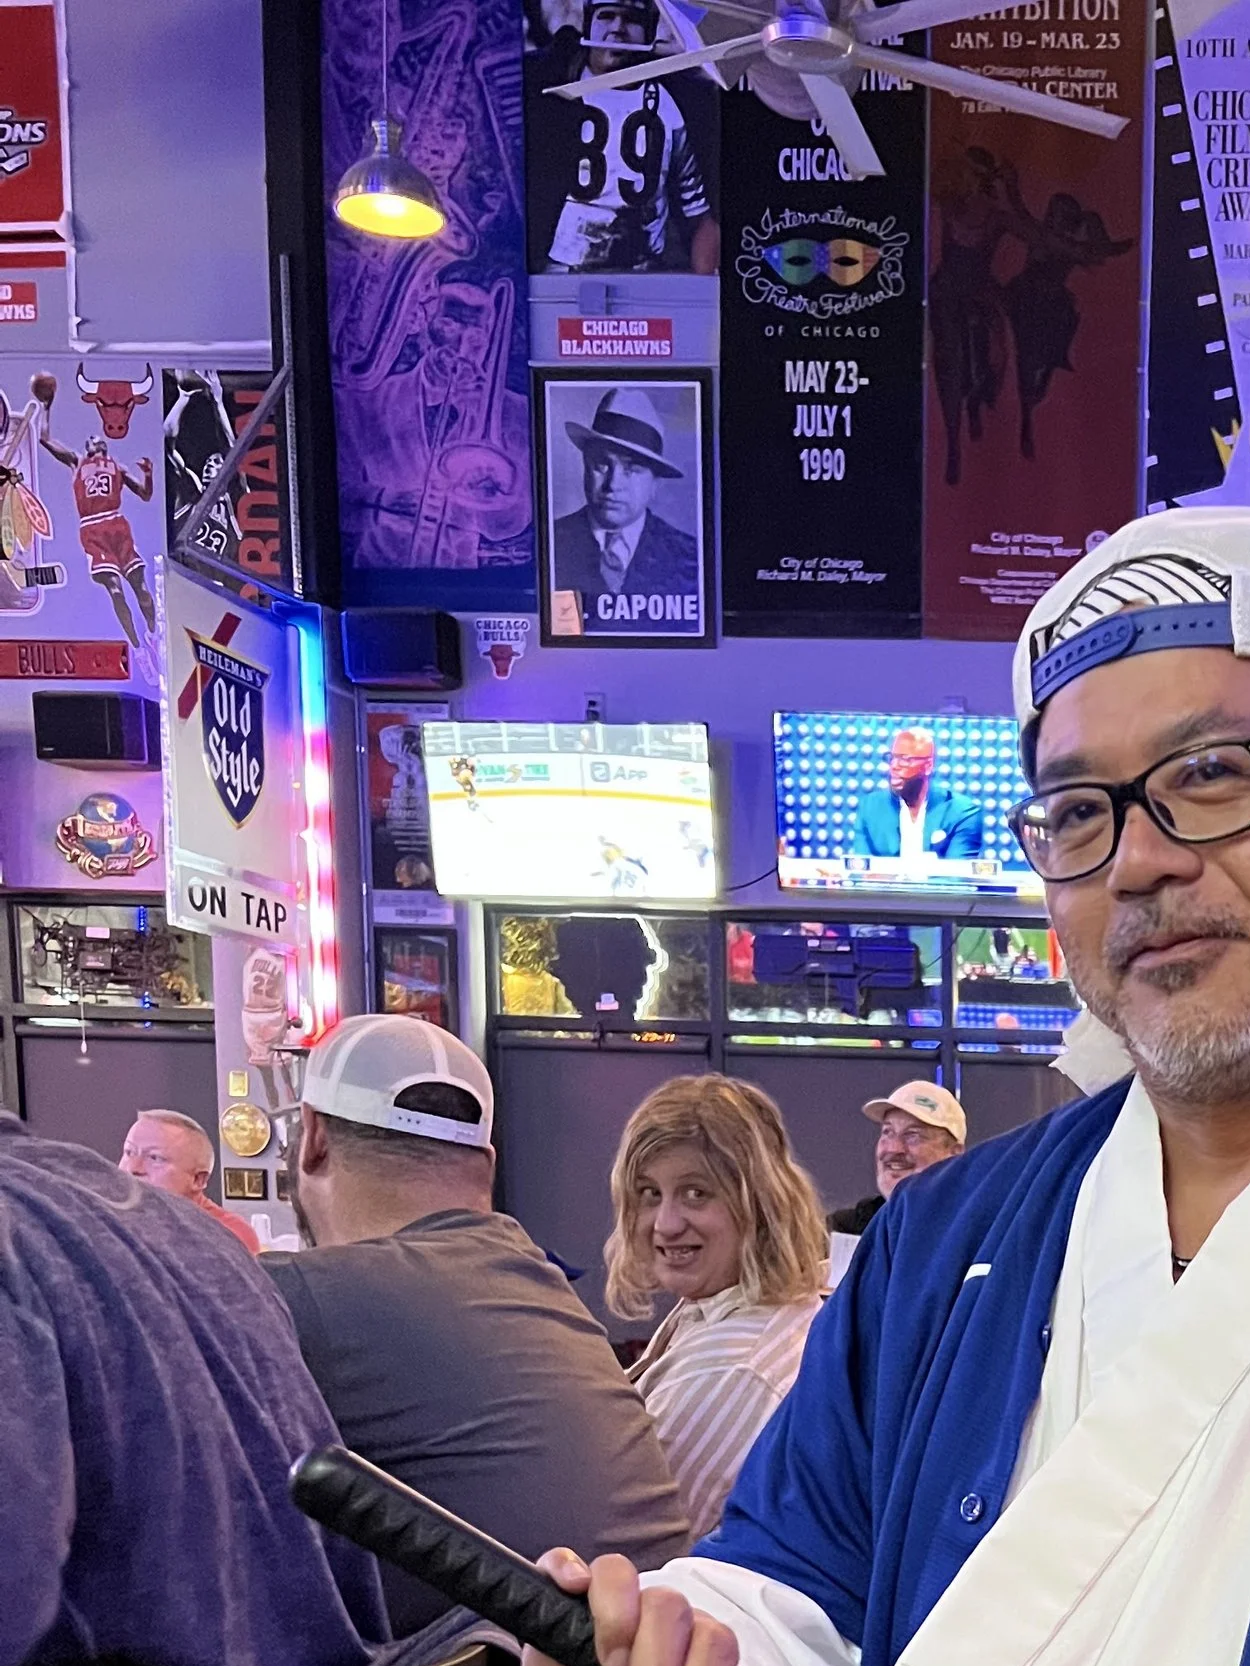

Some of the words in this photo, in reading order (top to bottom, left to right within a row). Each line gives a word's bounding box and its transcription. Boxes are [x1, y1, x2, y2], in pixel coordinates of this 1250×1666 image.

[951, 32, 993, 48] JAN.
[1003, 31, 1023, 48] 19
[1041, 32, 1090, 49] MAR.
[1096, 32, 1121, 49] 23
[1185, 38, 1236, 58] 10TH
[1031, 66, 1066, 78] Public
[1068, 66, 1108, 80] Library
[1045, 81, 1119, 99] CENTER
[582, 319, 648, 336] CHICAGO
[764, 325, 784, 337] OF
[800, 326, 881, 338] CHICAGO
[561, 339, 671, 356] BLACKHAWKS
[785, 361, 830, 393] MAY
[834, 361, 870, 393] 23-
[793, 405, 838, 437] JULY
[842, 405, 852, 437] 1
[800, 448, 846, 481] 1990
[85, 474, 112, 497] 23
[820, 557, 864, 571] Chicago
[597, 594, 698, 620] CAPONE
[475, 620, 529, 631] CHICAGO
[483, 631, 520, 642] BULLS
[18, 645, 76, 674] BULLS
[199, 646, 263, 688] HEILEMAN'S
[213, 677, 252, 738] Old
[208, 726, 261, 808] Style
[188, 876, 227, 919] ON
[241, 892, 288, 934] TAP
